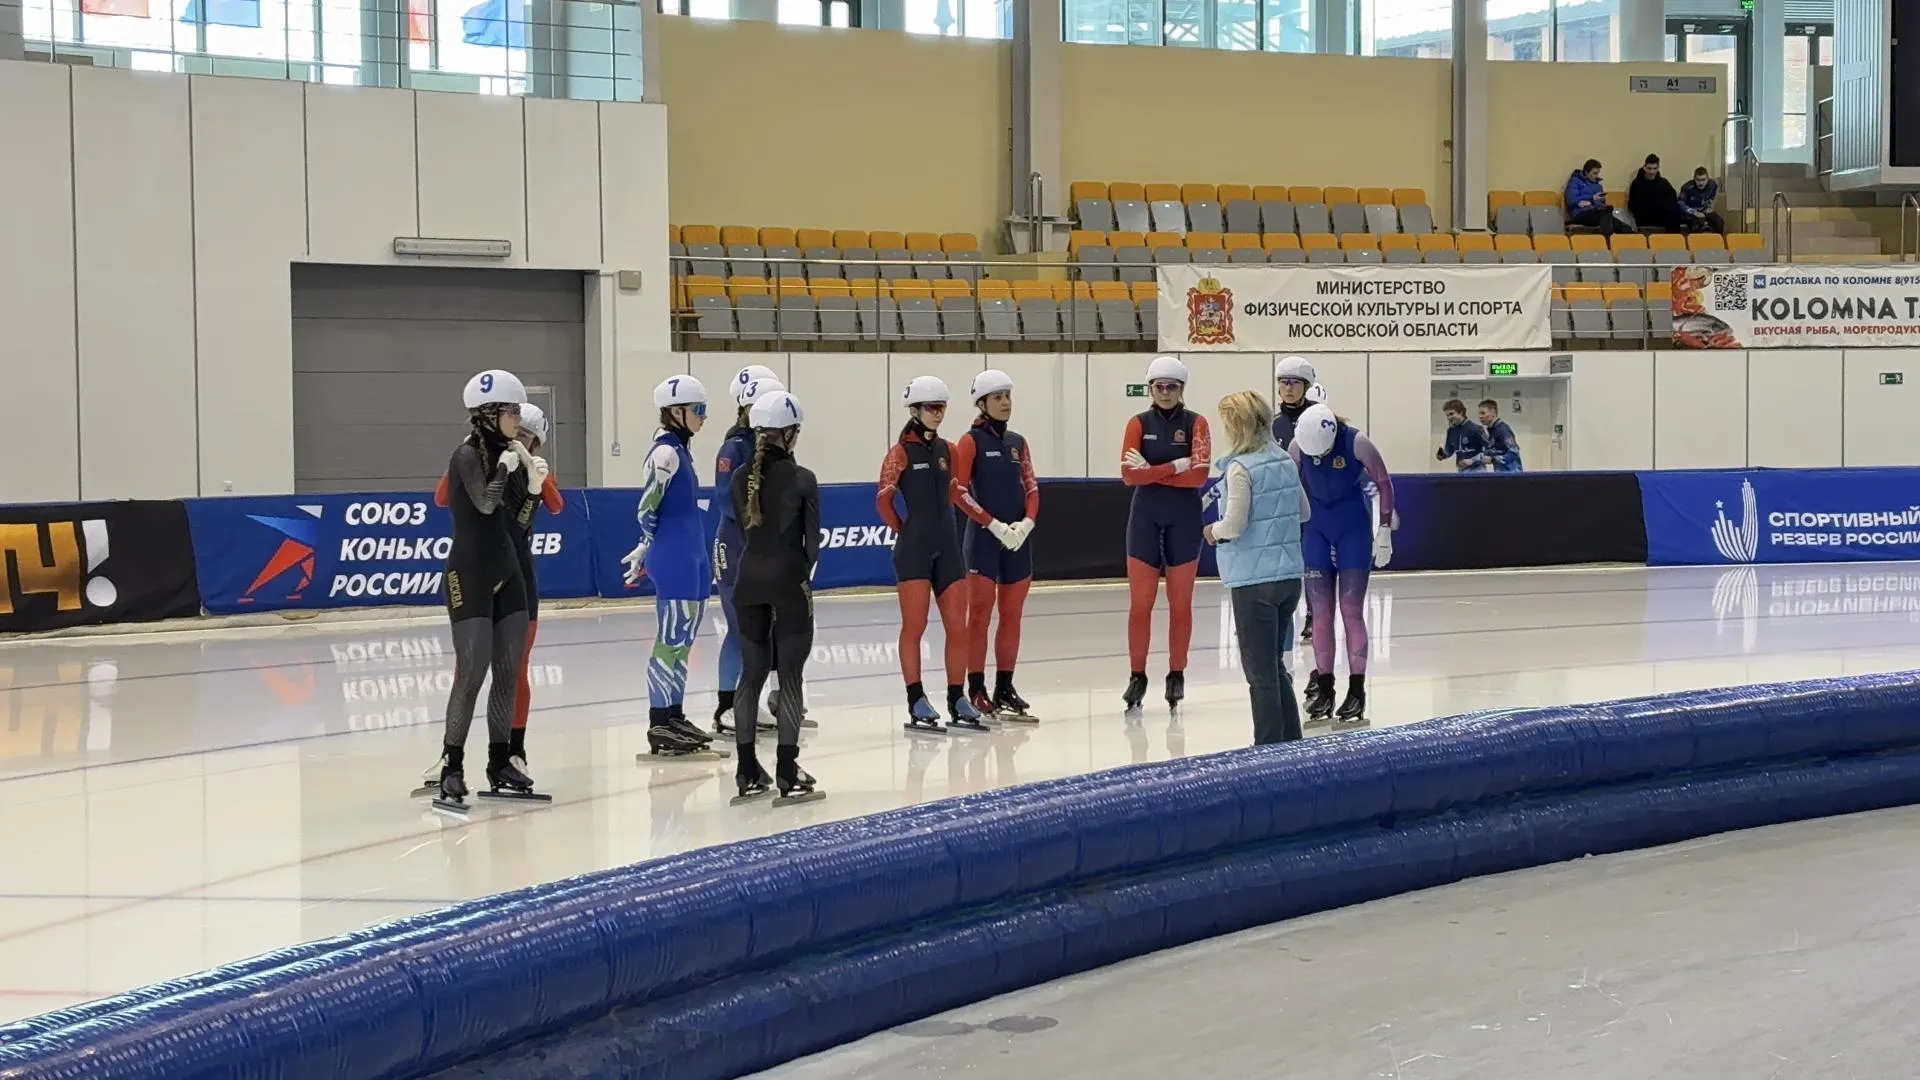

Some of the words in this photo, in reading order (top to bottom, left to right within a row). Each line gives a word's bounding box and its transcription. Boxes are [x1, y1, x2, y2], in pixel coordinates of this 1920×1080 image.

[1316, 281, 1446, 295] МИНИСТЕРСТВО
[1769, 276, 1821, 286] ДОСТАВКА
[1824, 276, 1839, 285] ПО
[1843, 276, 1892, 285] КОЛОМНЕ
[1244, 298, 1352, 317] ФИЗИЧЕСКОЙ
[1357, 302, 1440, 317] КУЛЬТУРЫ
[1444, 302, 1455, 316] И
[1459, 301, 1523, 315] СПОРТА
[1752, 297, 1897, 320] KOLOMNA
[1904, 297, 1920, 319] T
[1288, 320, 1399, 338] МОСКОВСКОЙ
[1403, 322, 1479, 337] ОБЛАСТИ
[1754, 326, 1802, 336] ВКУСНАЯ
[1806, 325, 1840, 336] РЫБА,
[480, 374, 494, 394] 9
[739, 369, 749, 385] 6
[668, 379, 680, 397] 7
[785, 397, 797, 418] 1
[1321, 419, 1336, 432] 3
[345, 502, 427, 526] СОЮЗ
[1768, 506, 1920, 528] СПОРТИВНЫЙ
[1771, 532, 1841, 546] РЕЗЕРВ
[1846, 531, 1920, 546] РОССИИ
[329, 572, 443, 598] РОССИИ
